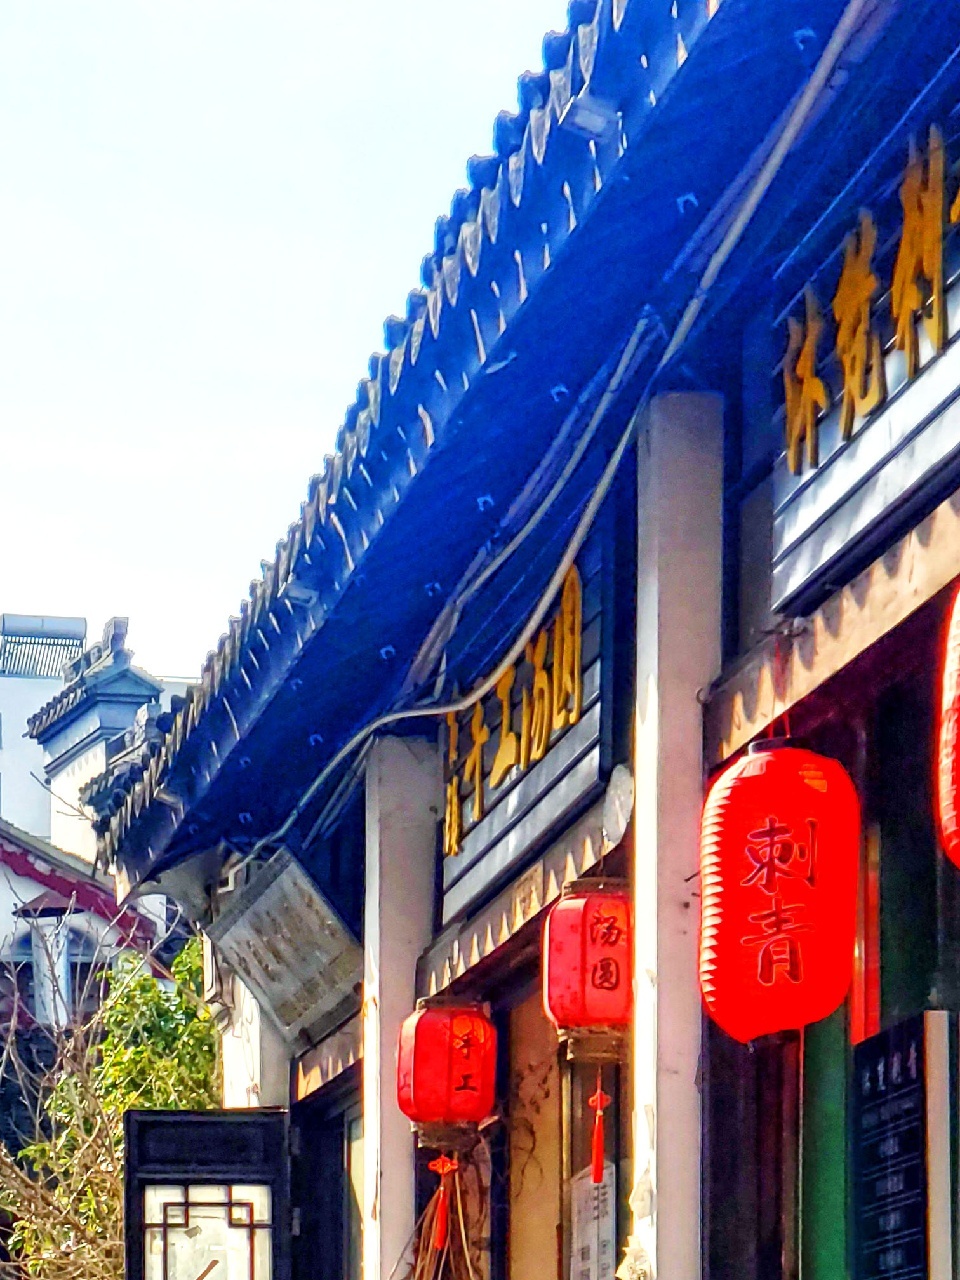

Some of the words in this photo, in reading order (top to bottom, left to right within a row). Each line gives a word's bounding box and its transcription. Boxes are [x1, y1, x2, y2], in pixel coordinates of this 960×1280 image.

[740, 815, 819, 987] 刺青
[589, 914, 622, 991] 汤圆
[453, 1032, 479, 1092] 手工
